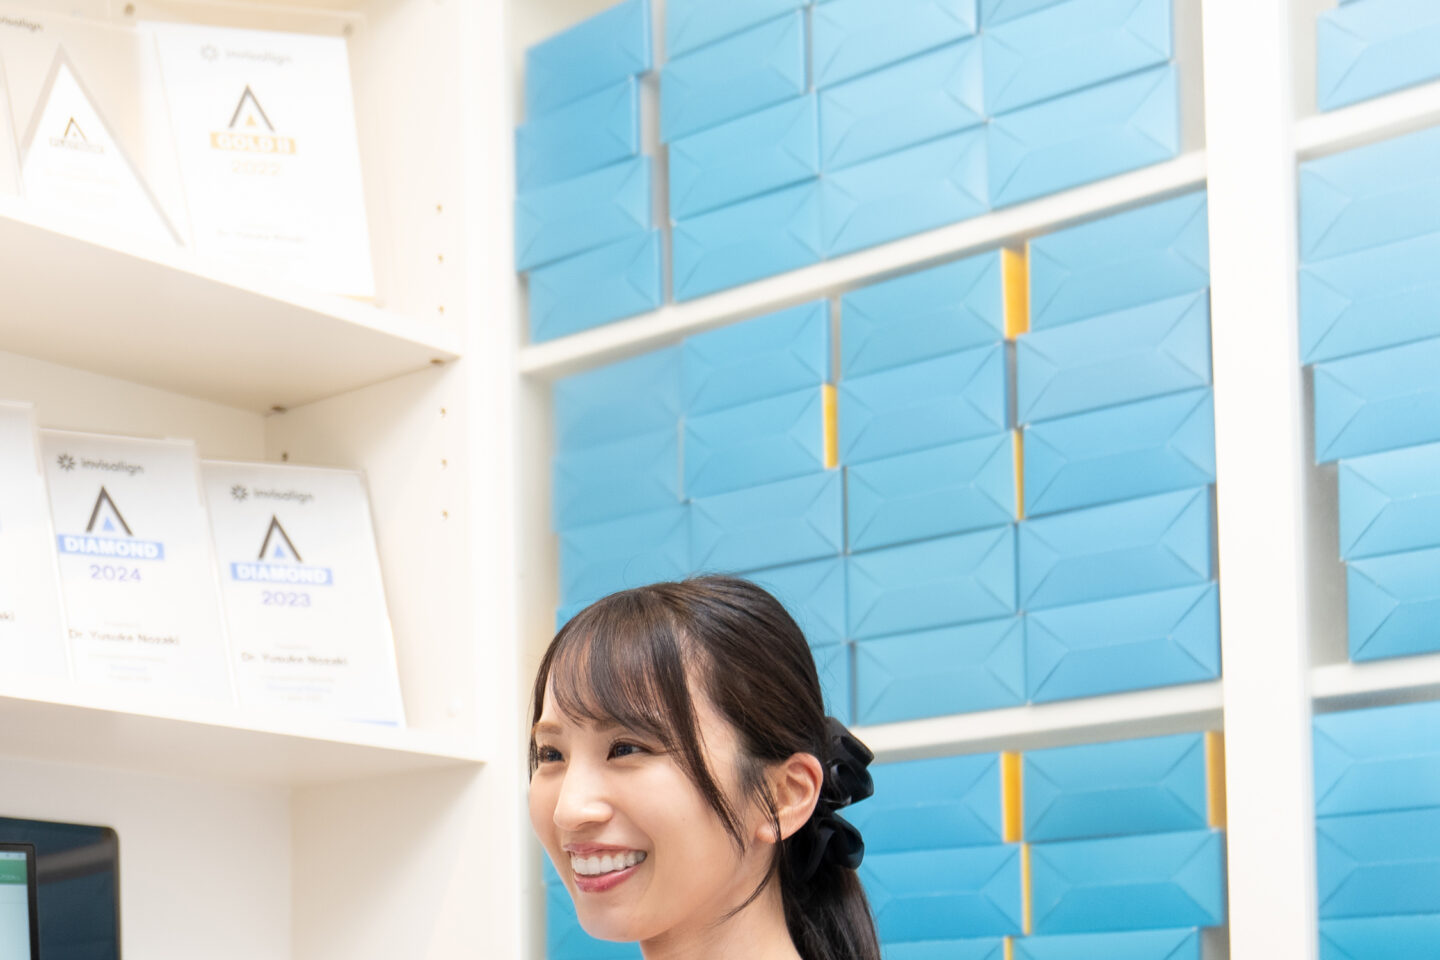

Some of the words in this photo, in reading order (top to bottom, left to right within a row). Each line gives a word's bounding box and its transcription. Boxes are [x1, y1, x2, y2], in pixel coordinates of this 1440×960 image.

[81, 458, 145, 476] invisalign
[63, 536, 159, 559] DIAMOND
[89, 564, 143, 583] 2024
[237, 564, 327, 585] DIAMOND
[261, 591, 312, 608] 2023
